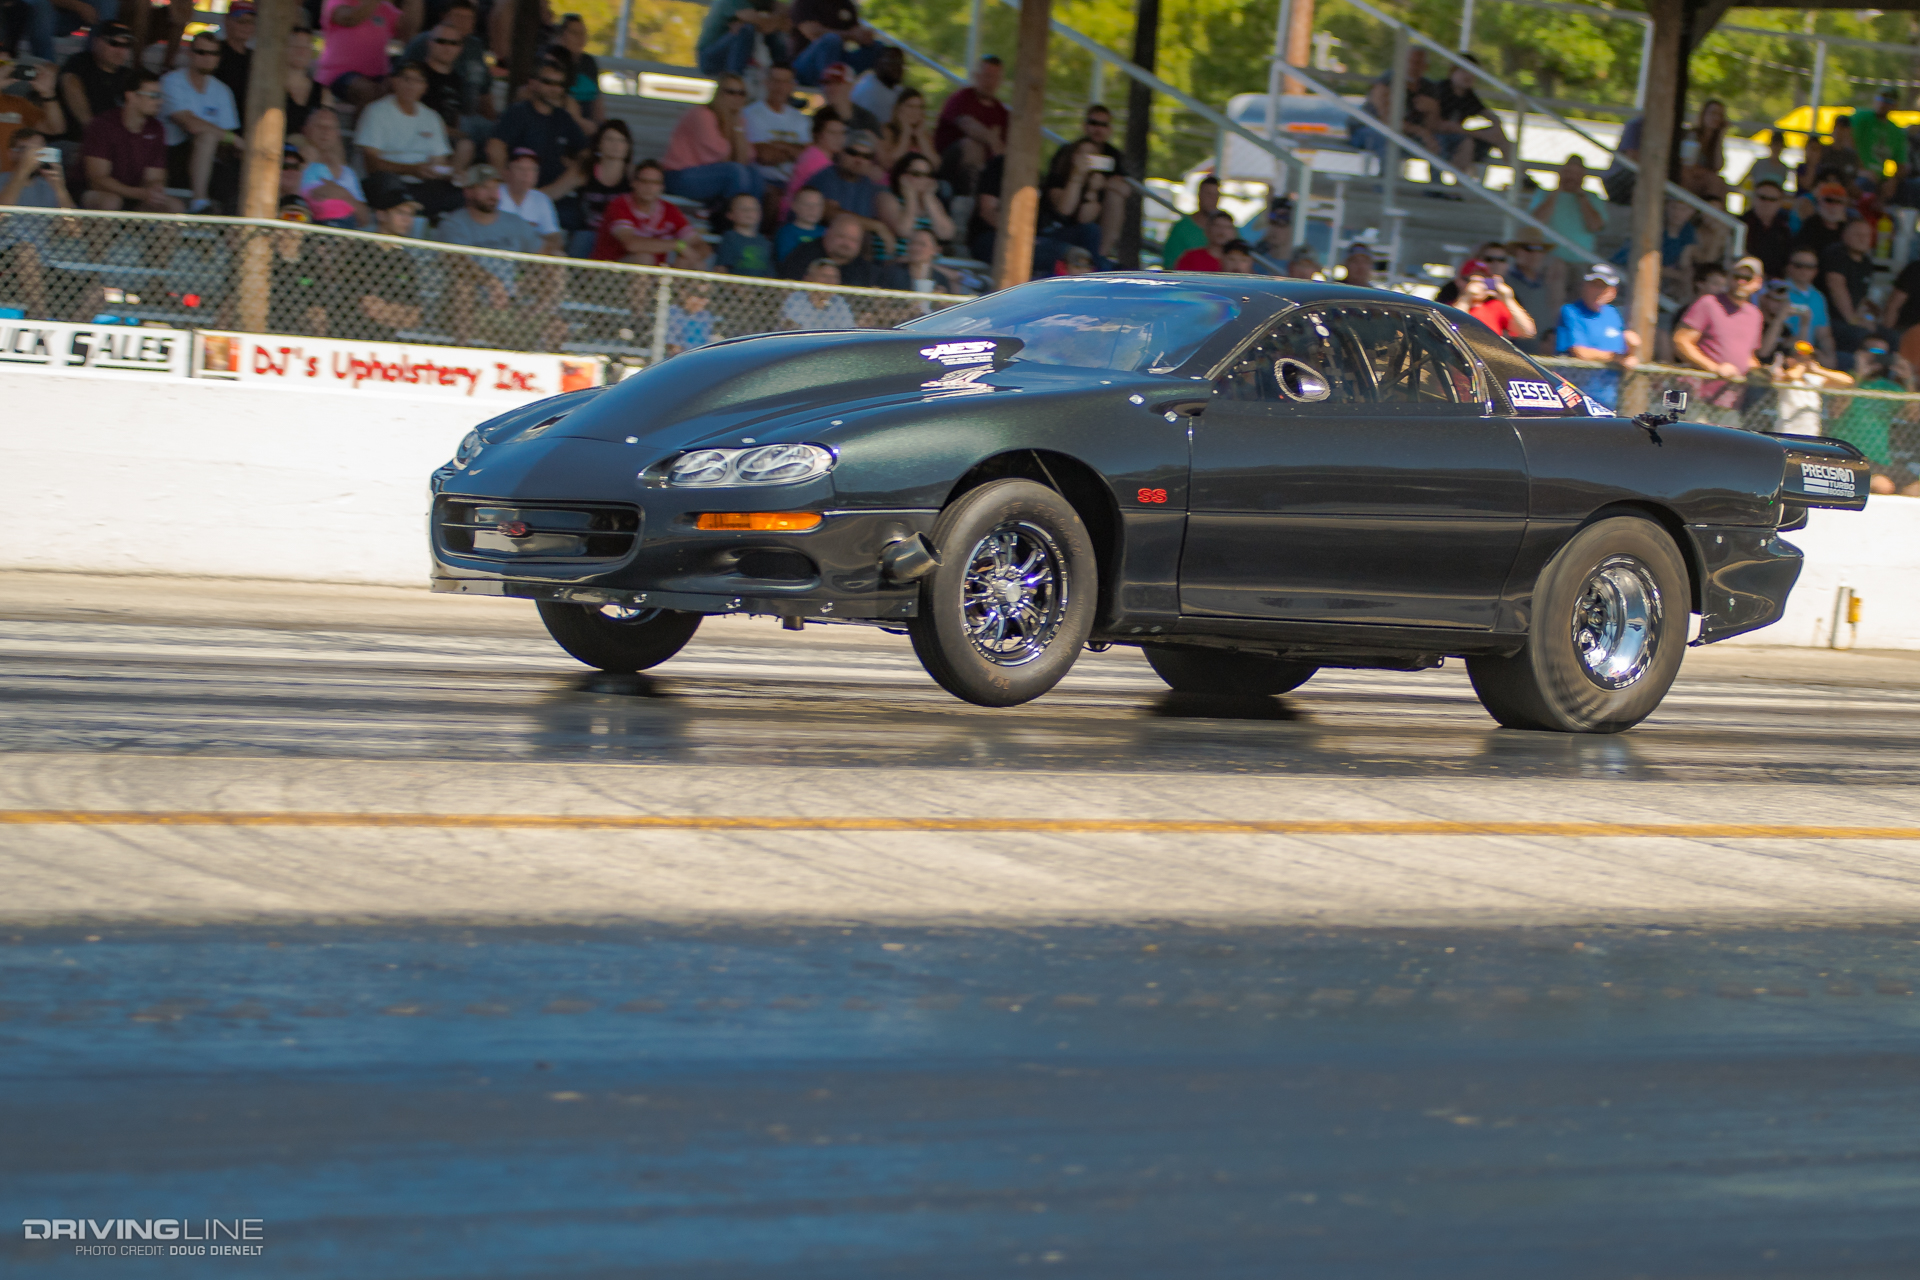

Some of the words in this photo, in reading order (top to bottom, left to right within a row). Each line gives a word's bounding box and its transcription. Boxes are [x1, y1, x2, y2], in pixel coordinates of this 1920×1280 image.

[67, 330, 174, 366] SALES
[253, 344, 318, 377] DJ's
[331, 351, 483, 396] Upholstery
[493, 362, 545, 393] Inc.
[1509, 381, 1560, 401] JESEL
[1801, 463, 1855, 483] PRECISION
[1828, 480, 1855, 491] TURBO
[1137, 488, 1168, 504] SS
